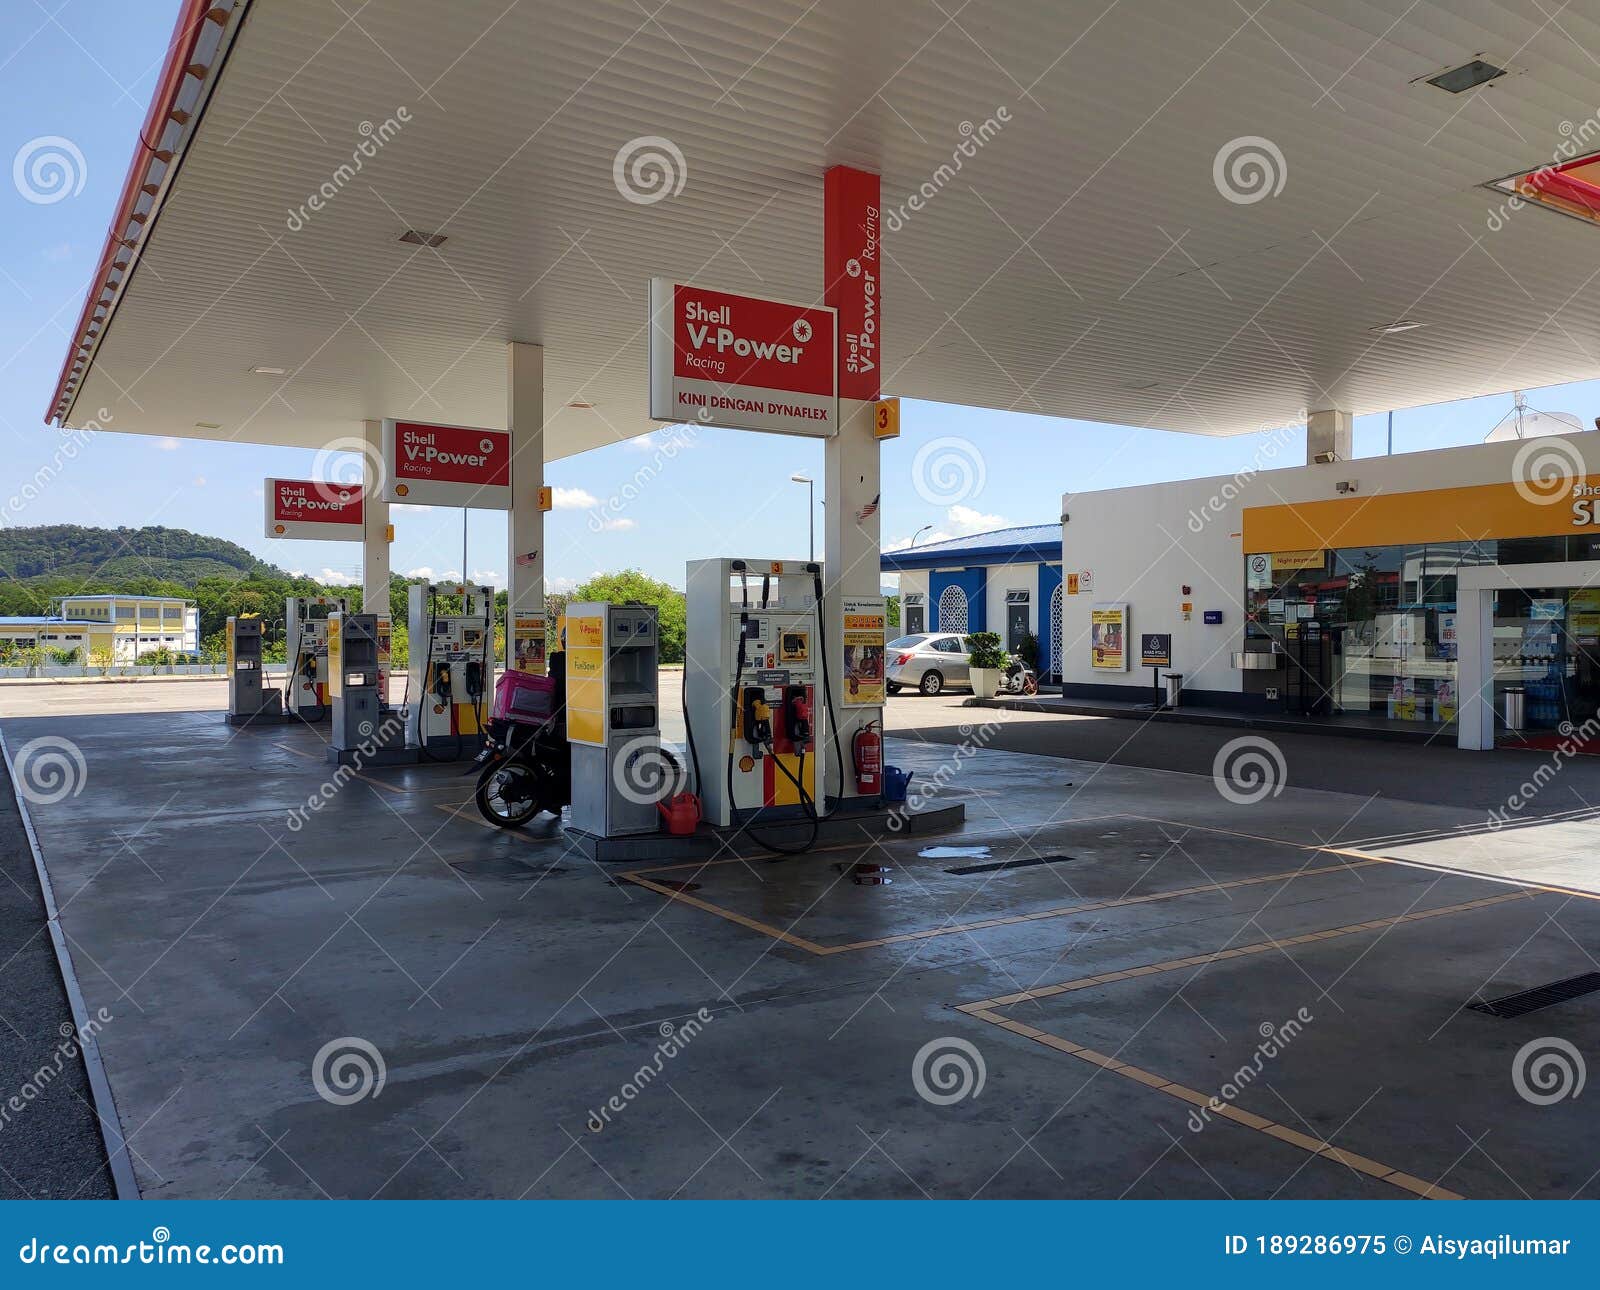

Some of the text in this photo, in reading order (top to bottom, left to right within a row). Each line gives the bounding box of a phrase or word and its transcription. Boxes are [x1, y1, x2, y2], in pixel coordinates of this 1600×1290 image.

[862, 205, 879, 260] Racing
[685, 301, 730, 325] Shell
[860, 270, 875, 373] V-Power
[685, 323, 803, 364] V-Power
[847, 333, 858, 372] Shell
[685, 352, 725, 374] Racing
[678, 391, 828, 420] KINI DENGAN DYNAFLEX
[878, 408, 888, 428] 3
[403, 431, 435, 446] Shell
[403, 444, 488, 467] V-Power
[403, 461, 432, 475] Racing
[280, 486, 305, 497] Shell
[280, 509, 303, 518] Racing
[281, 497, 346, 511] V-Power
[774, 562, 780, 573] 3
[1277, 557, 1292, 566] Night
